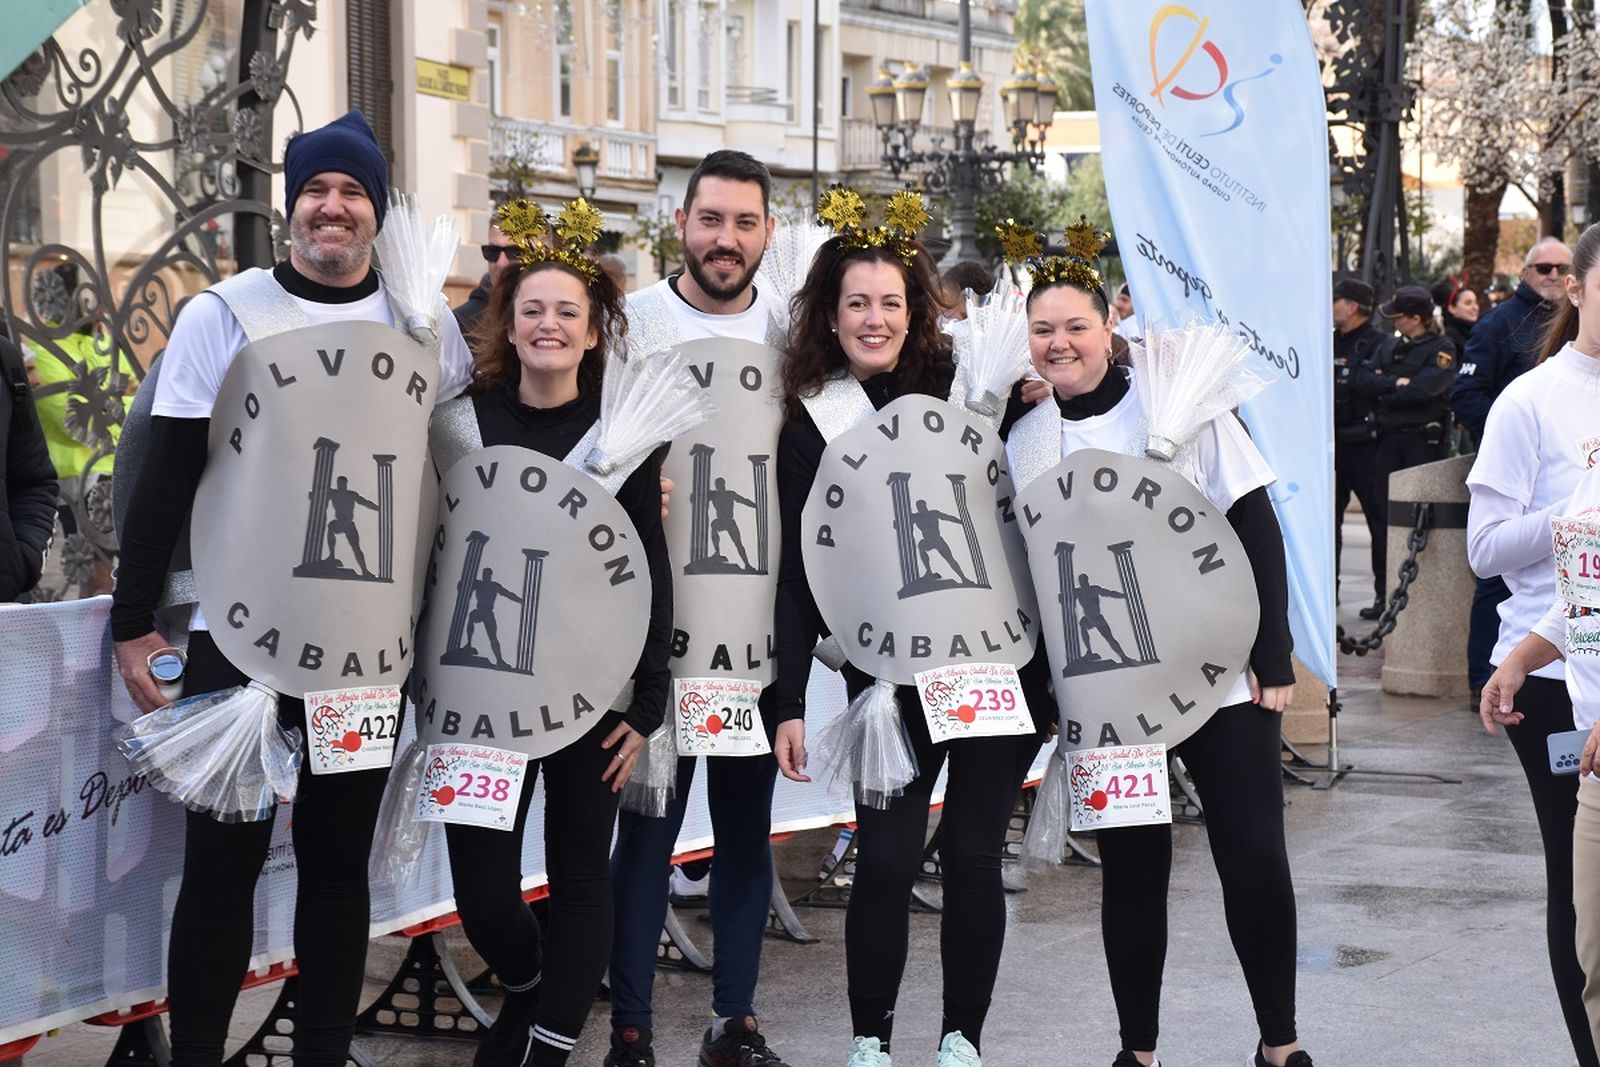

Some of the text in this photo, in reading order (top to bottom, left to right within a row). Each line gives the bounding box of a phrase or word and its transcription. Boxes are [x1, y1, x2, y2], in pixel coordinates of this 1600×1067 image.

[229, 349, 428, 455] POLVOR
[1022, 467, 1226, 576] LVORÓN
[671, 628, 777, 671] BALL
[857, 608, 1032, 658] CABALLA
[419, 678, 596, 739] CABALLA
[721, 707, 753, 731] 240
[969, 689, 1016, 711] 239
[1067, 662, 1228, 747] BALLA
[359, 714, 396, 740] 422
[43, 807, 71, 838] es
[80, 771, 150, 827] Depo
[455, 773, 511, 802] 238
[1105, 773, 1158, 799] 421
